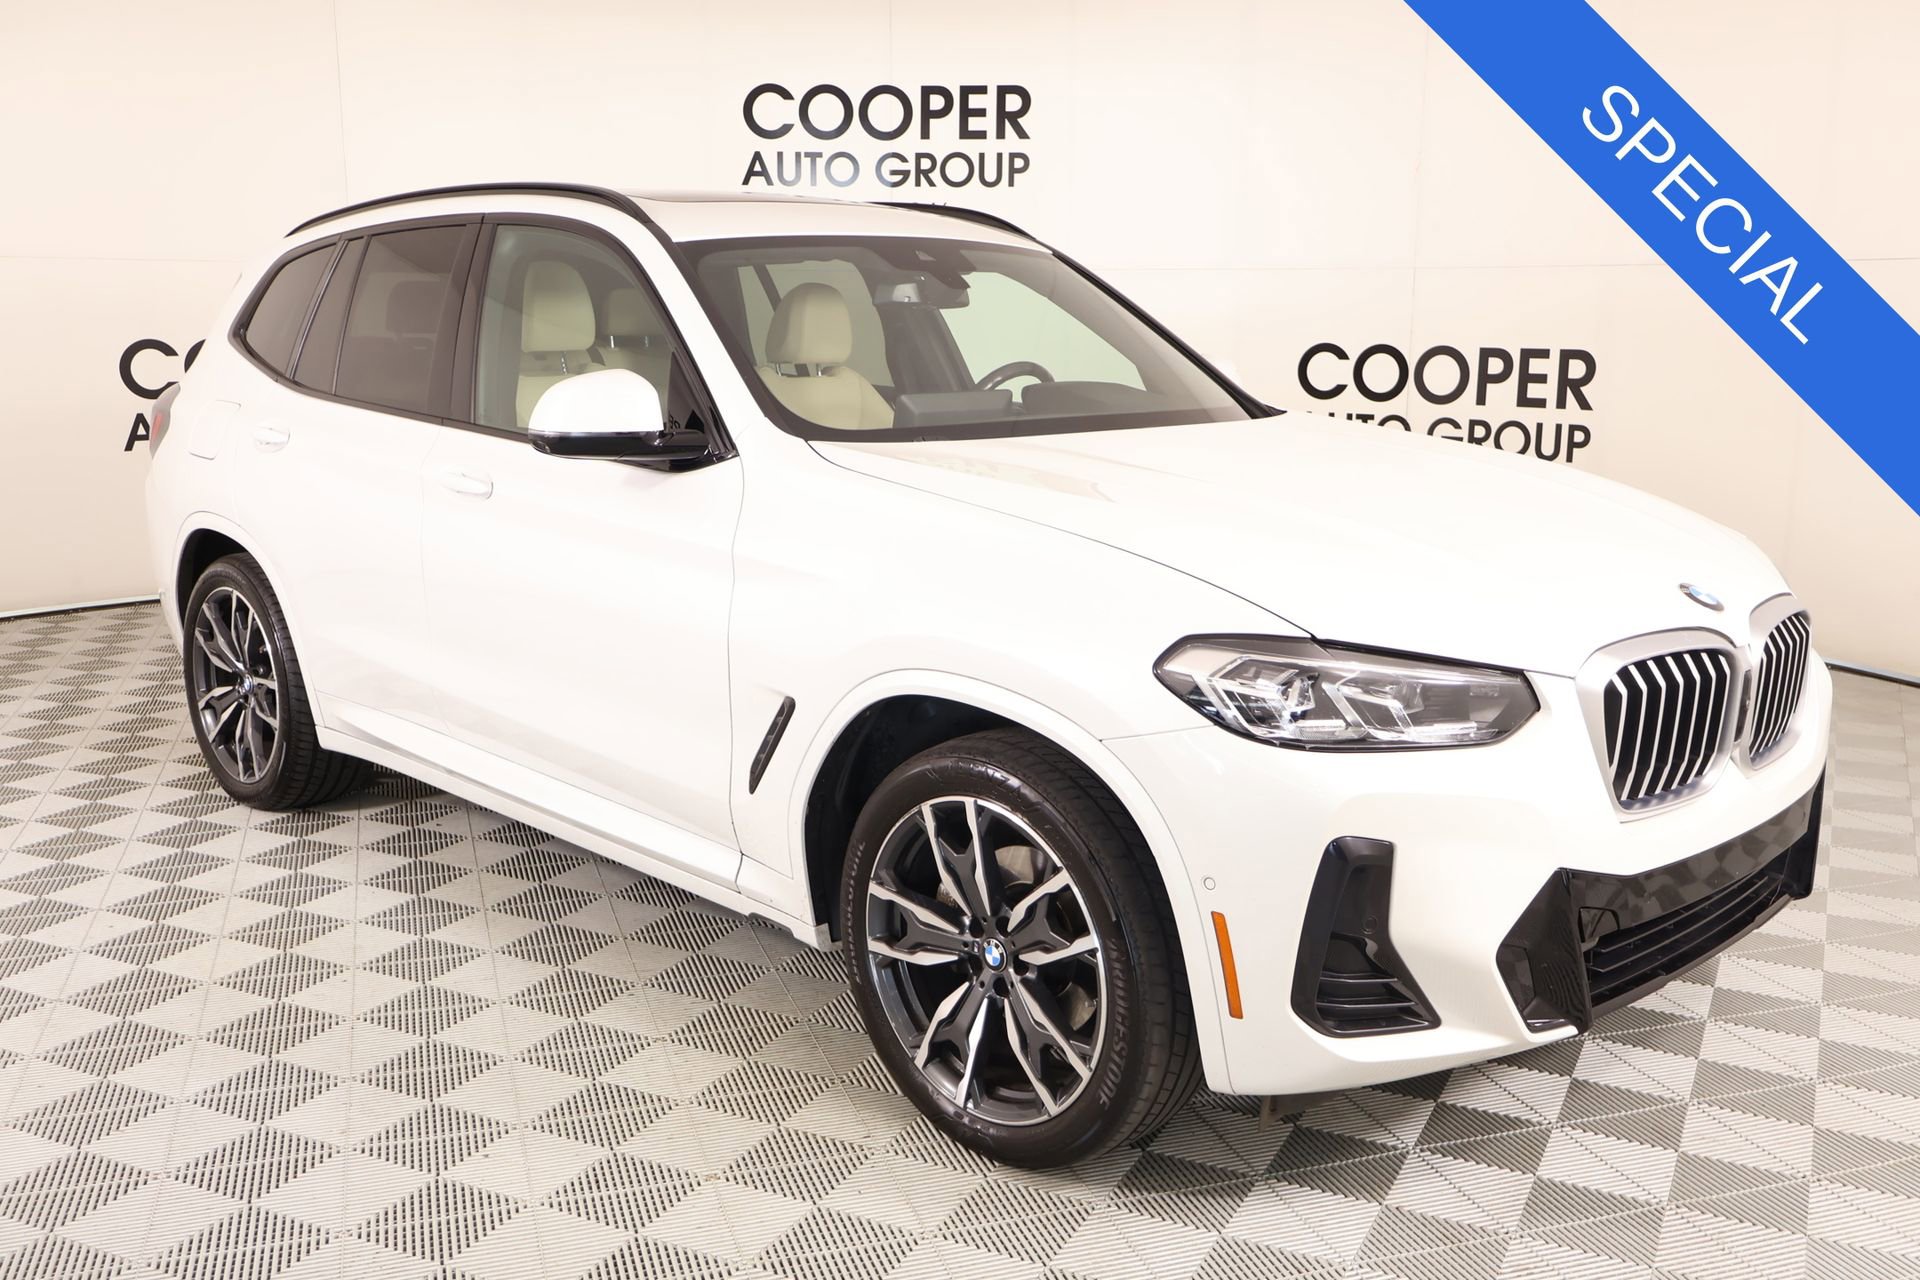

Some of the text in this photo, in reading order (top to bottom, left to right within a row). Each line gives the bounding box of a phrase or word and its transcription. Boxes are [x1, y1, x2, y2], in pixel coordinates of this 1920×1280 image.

[743, 83, 1031, 140] COOPER
[742, 151, 1030, 188] AUTO GROUP
[1298, 342, 1596, 411] COOPER
[1427, 417, 1591, 463] GROUP
